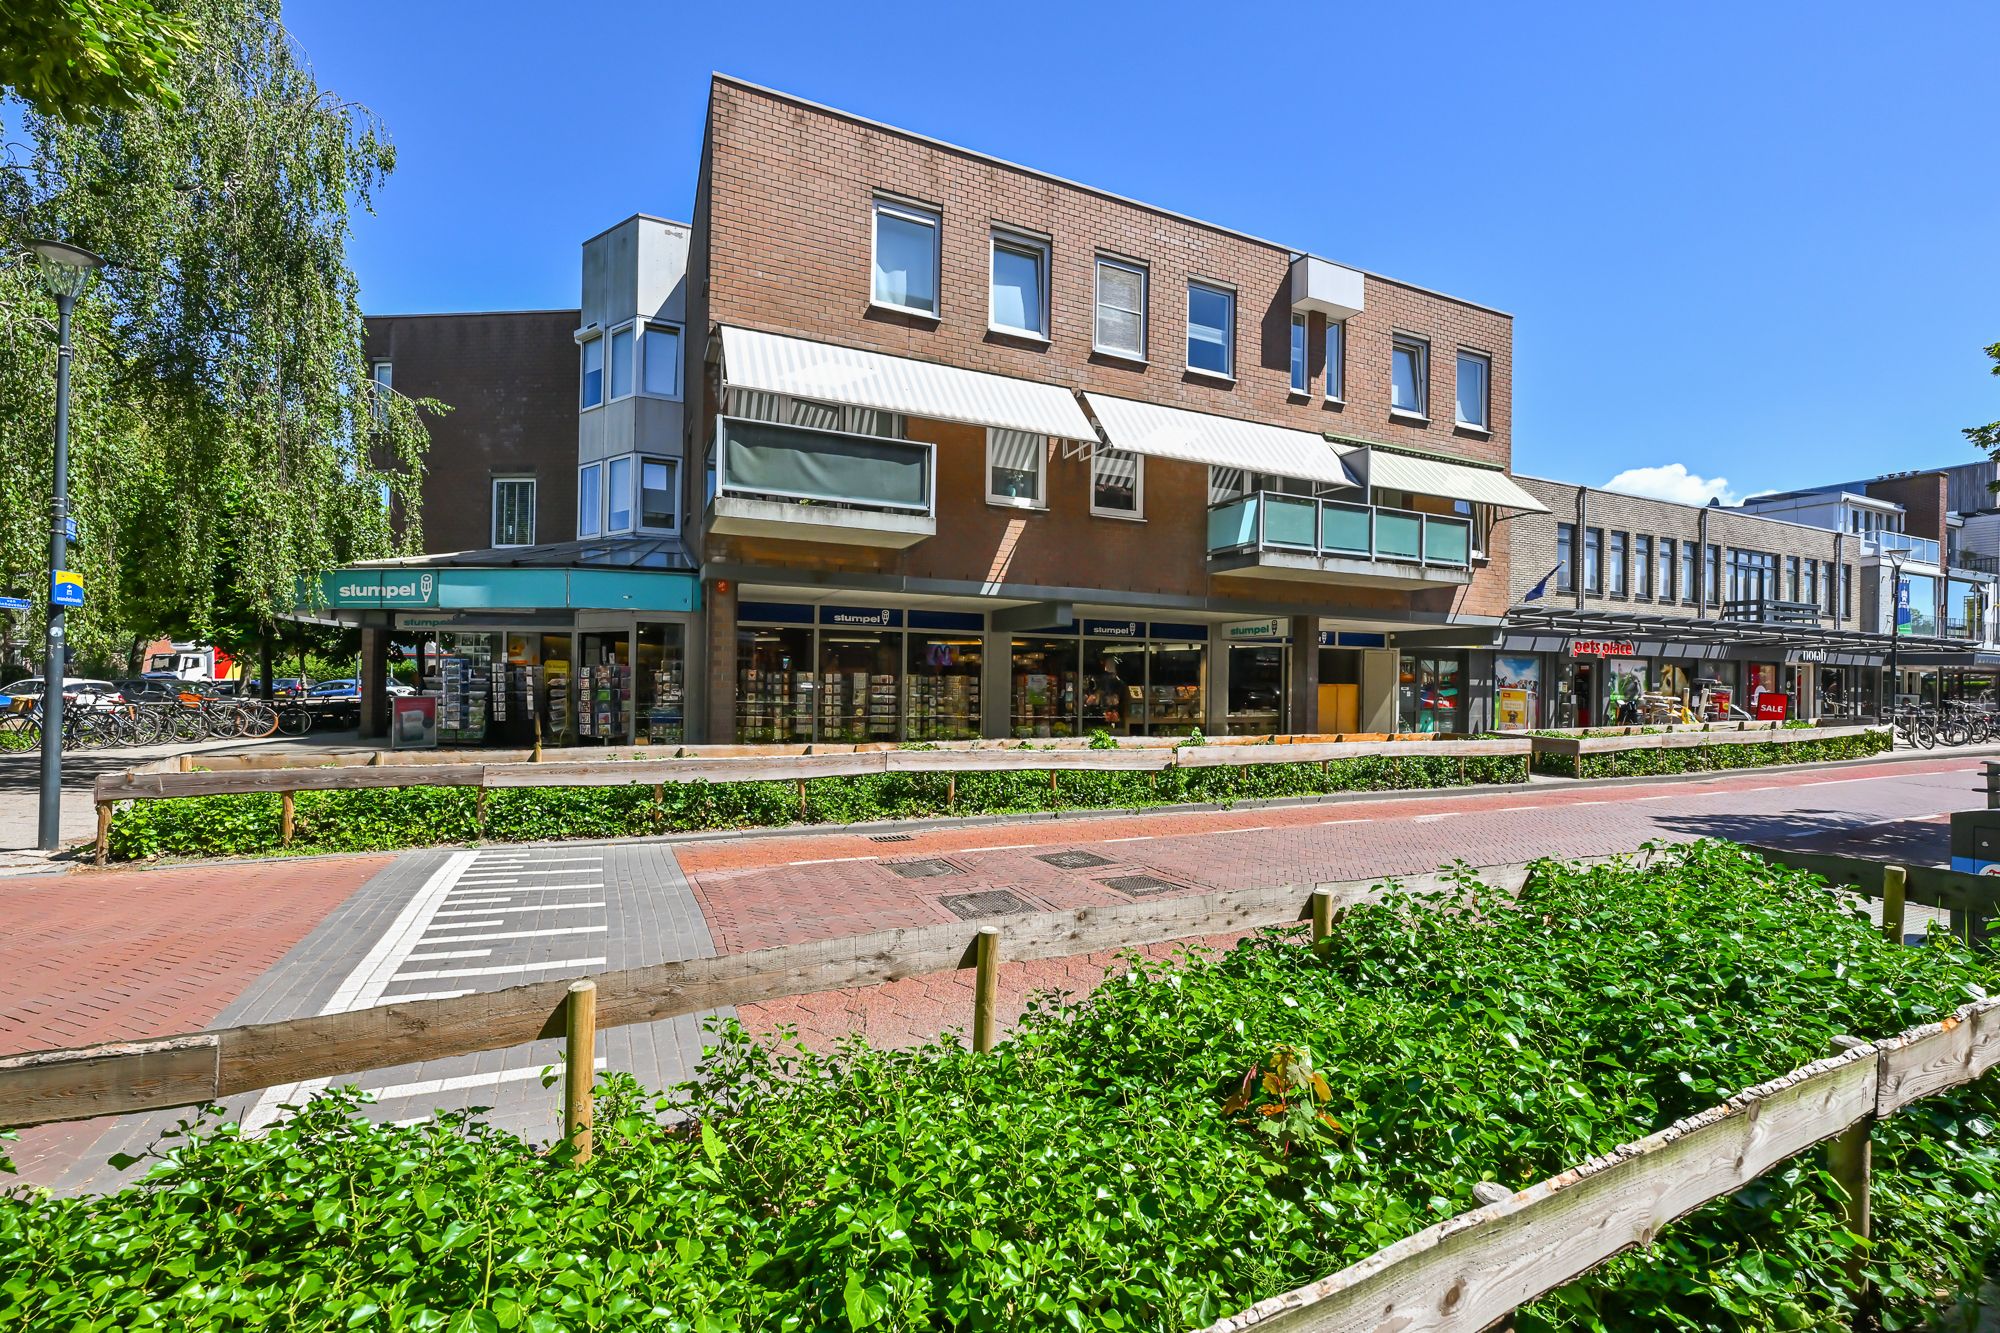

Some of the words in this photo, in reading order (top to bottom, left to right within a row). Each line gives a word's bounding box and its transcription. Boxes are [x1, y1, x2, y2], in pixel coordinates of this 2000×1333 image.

[339, 583, 416, 598] stumpel
[403, 619, 451, 627] stumpe
[834, 614, 880, 624] stumpel
[1230, 625, 1270, 635] stumpel
[1574, 640, 1600, 656] pets
[1602, 641, 1632, 657] place
[1760, 704, 1783, 713] SALE
